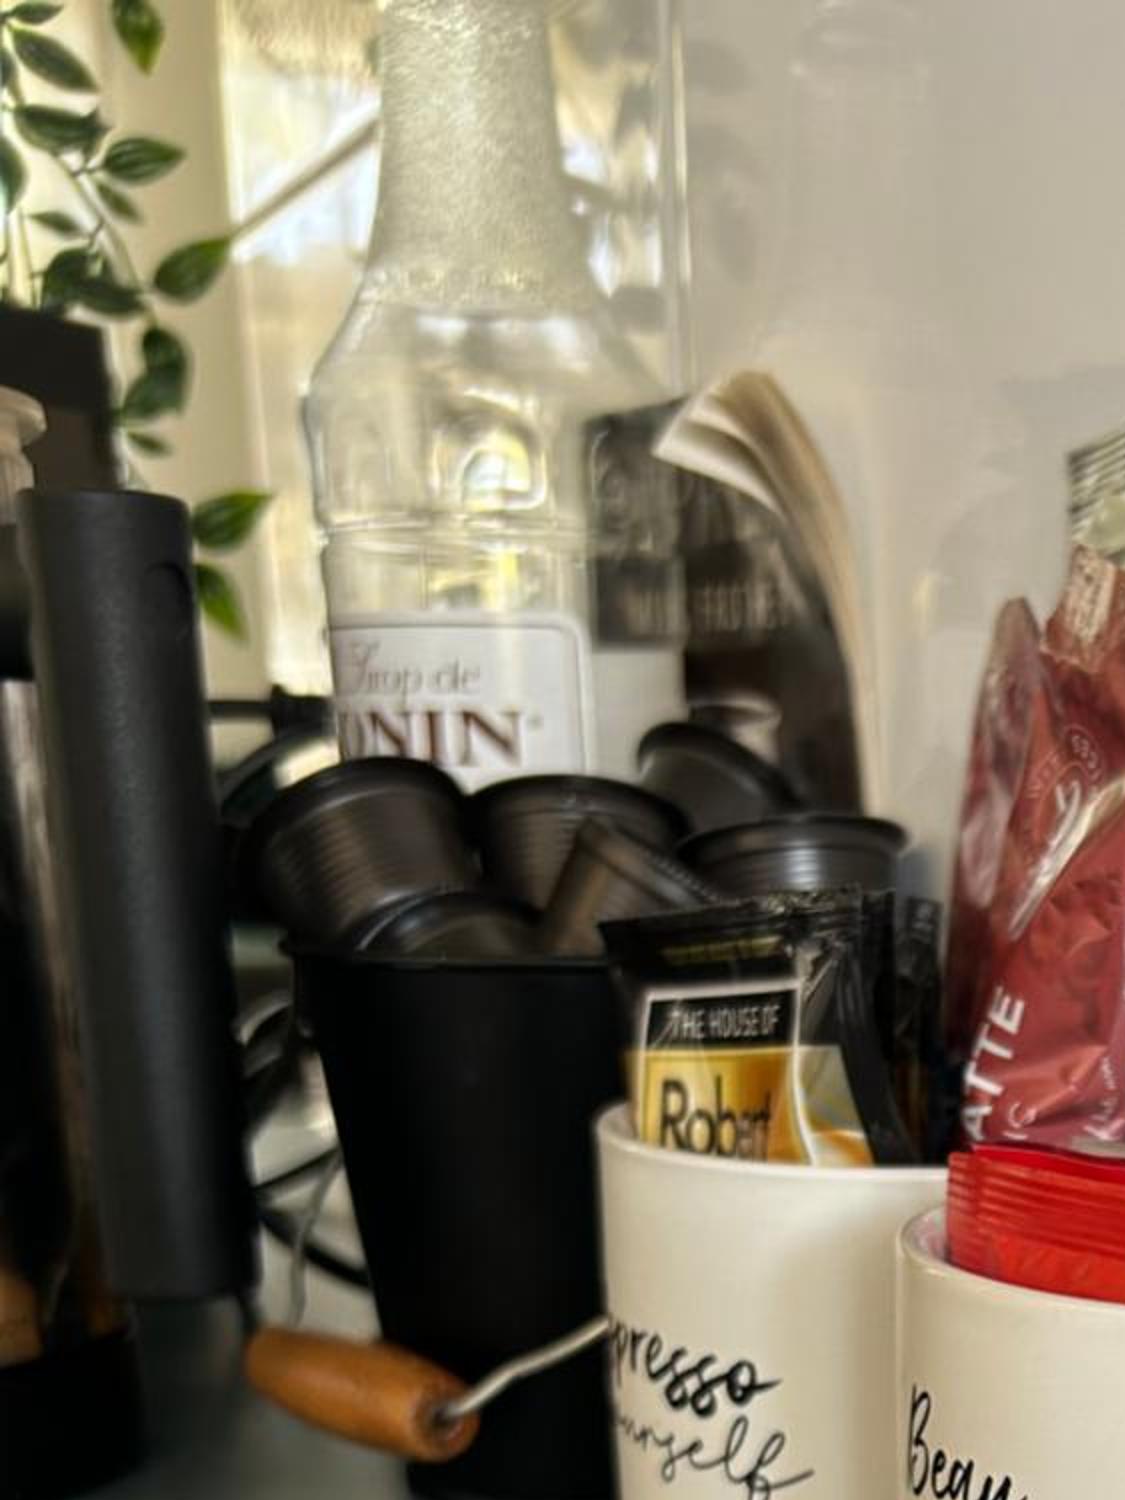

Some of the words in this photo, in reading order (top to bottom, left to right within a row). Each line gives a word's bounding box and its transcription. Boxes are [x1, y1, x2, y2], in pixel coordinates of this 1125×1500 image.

[669, 1006, 705, 1039] THE
[709, 1005, 760, 1039] HOUSE
[762, 1004, 781, 1036] OF
[962, 985, 1025, 1141] ATTE
[607, 1313, 783, 1419] presso
